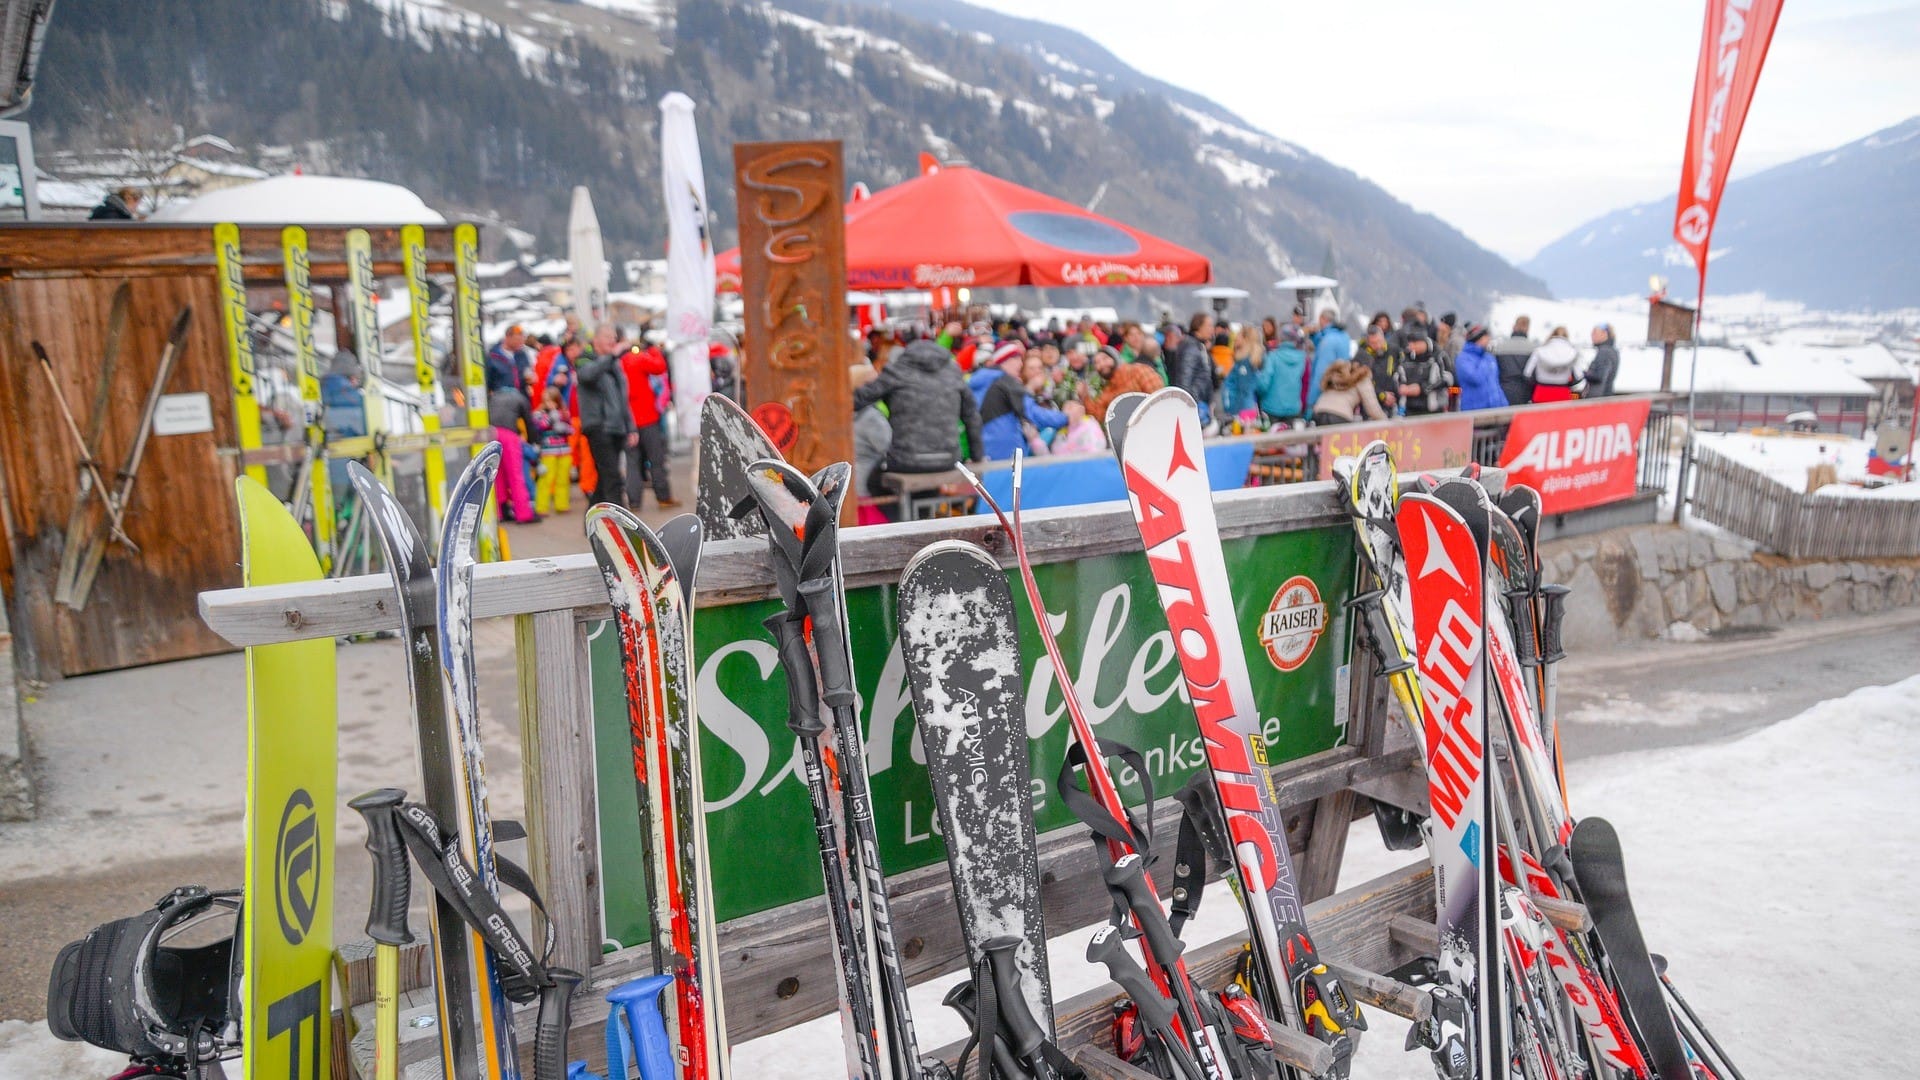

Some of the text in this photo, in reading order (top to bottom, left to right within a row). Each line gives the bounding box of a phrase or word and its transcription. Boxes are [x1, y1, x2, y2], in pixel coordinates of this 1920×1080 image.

[225, 243, 256, 375] FISCHER
[291, 246, 320, 380] FISCHER
[357, 250, 382, 379] FISCHER
[412, 244, 435, 367] FISCHER
[462, 243, 487, 367] FISCHER
[1503, 422, 1634, 473] ALPINA
[1123, 461, 1278, 894] ATOMIC
[1269, 607, 1318, 636] KAISER
[1419, 598, 1483, 734] ATO
[1252, 736, 1268, 765] RC
[1428, 695, 1484, 832] MIC
[487, 912, 532, 977] GABEL
[863, 839, 901, 976] SCOTT
